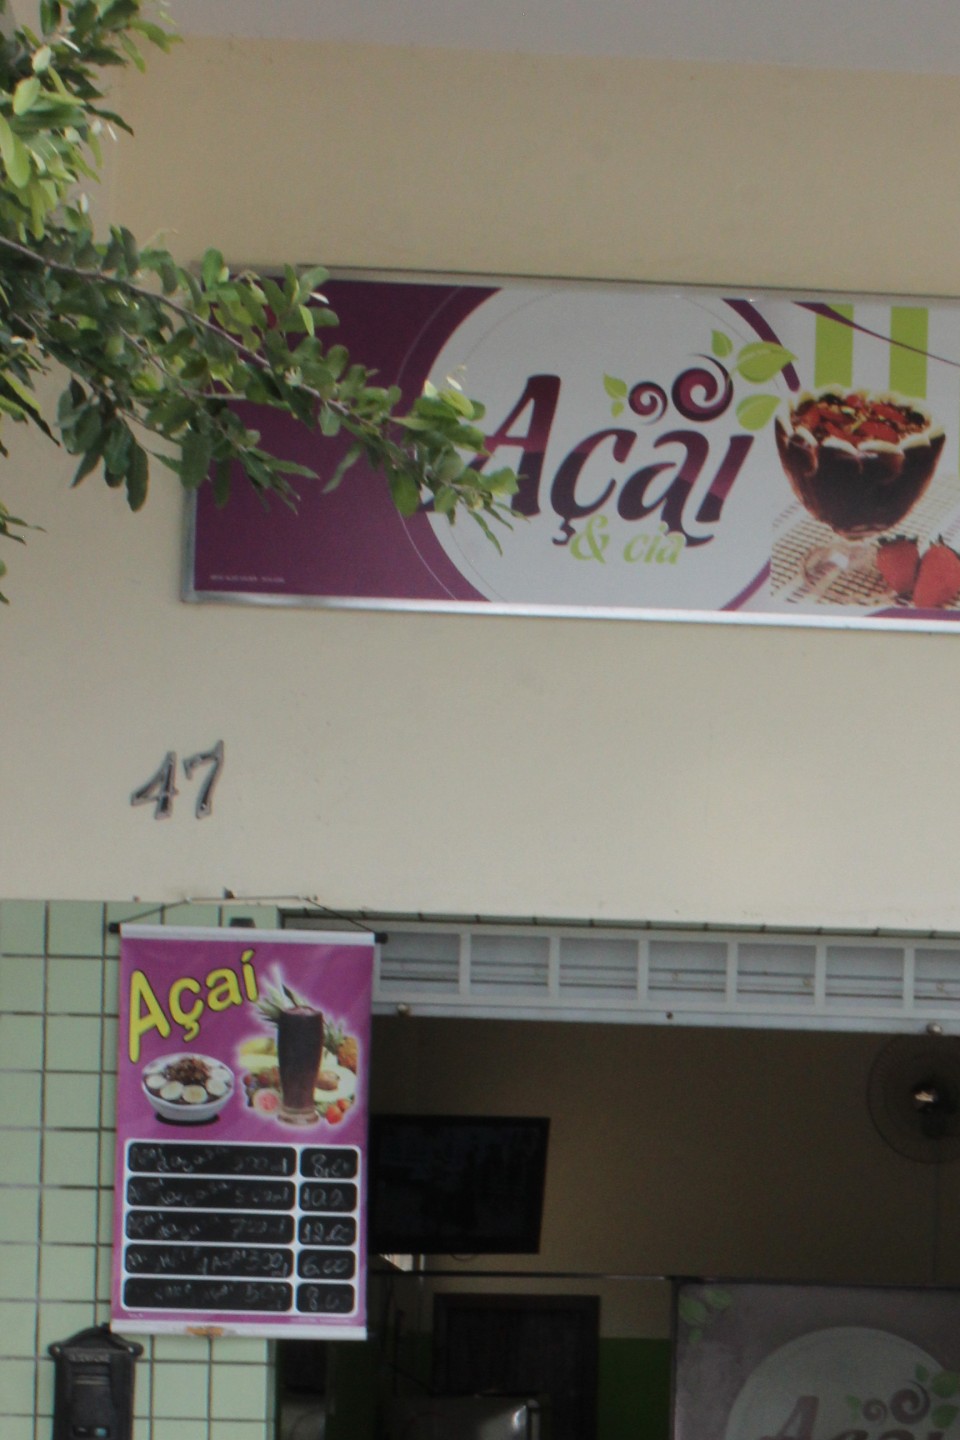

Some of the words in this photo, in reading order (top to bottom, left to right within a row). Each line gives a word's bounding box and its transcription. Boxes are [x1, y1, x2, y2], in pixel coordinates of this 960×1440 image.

[570, 514, 609, 565] &
[623, 521, 687, 565] cia
[130, 739, 225, 820] 47
[128, 949, 259, 1064] Açaí
